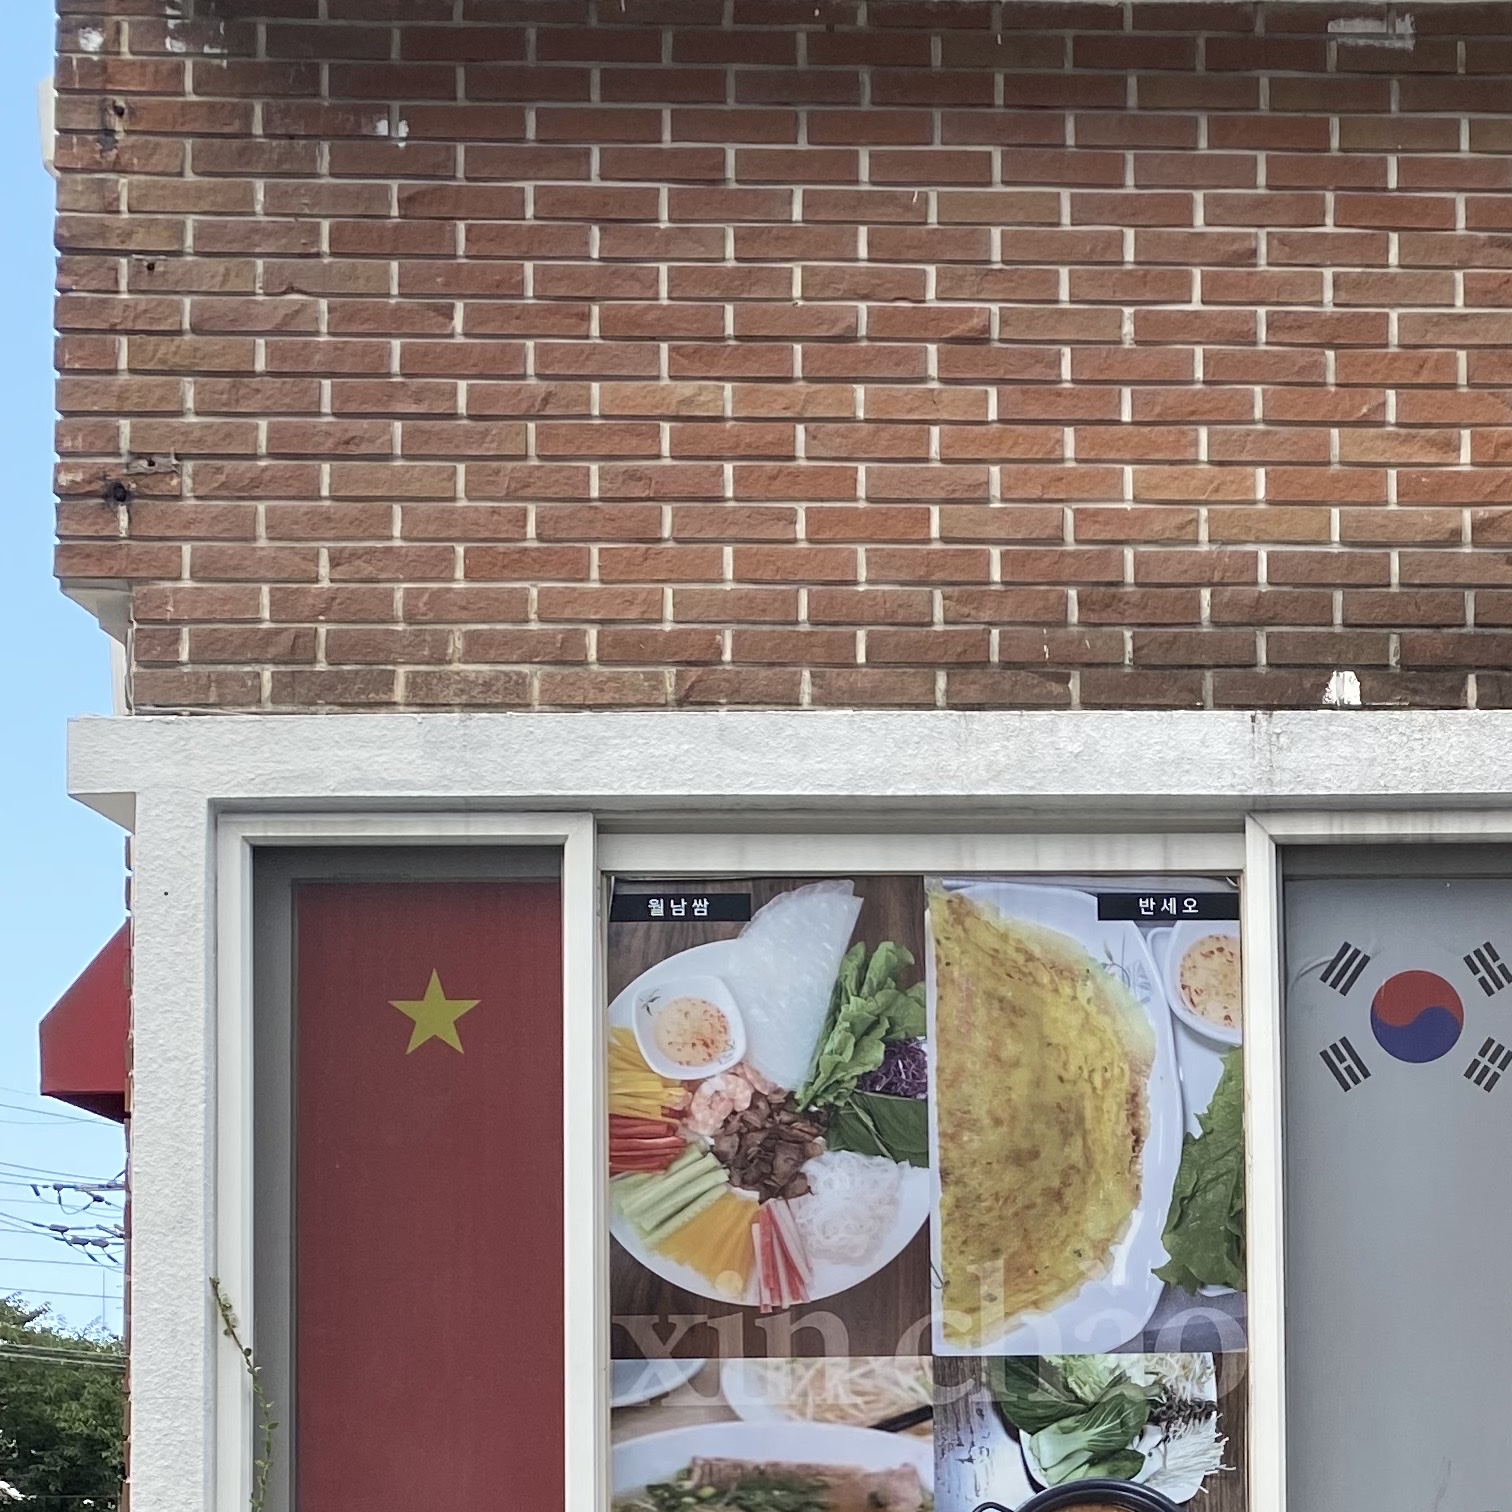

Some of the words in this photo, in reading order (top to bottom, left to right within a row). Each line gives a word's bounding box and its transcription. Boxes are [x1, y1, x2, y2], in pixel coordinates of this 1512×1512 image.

[648, 897, 709, 917] 월남쌈
[1138, 897, 1199, 916] 반세오
[611, 1270, 862, 1407] xin
